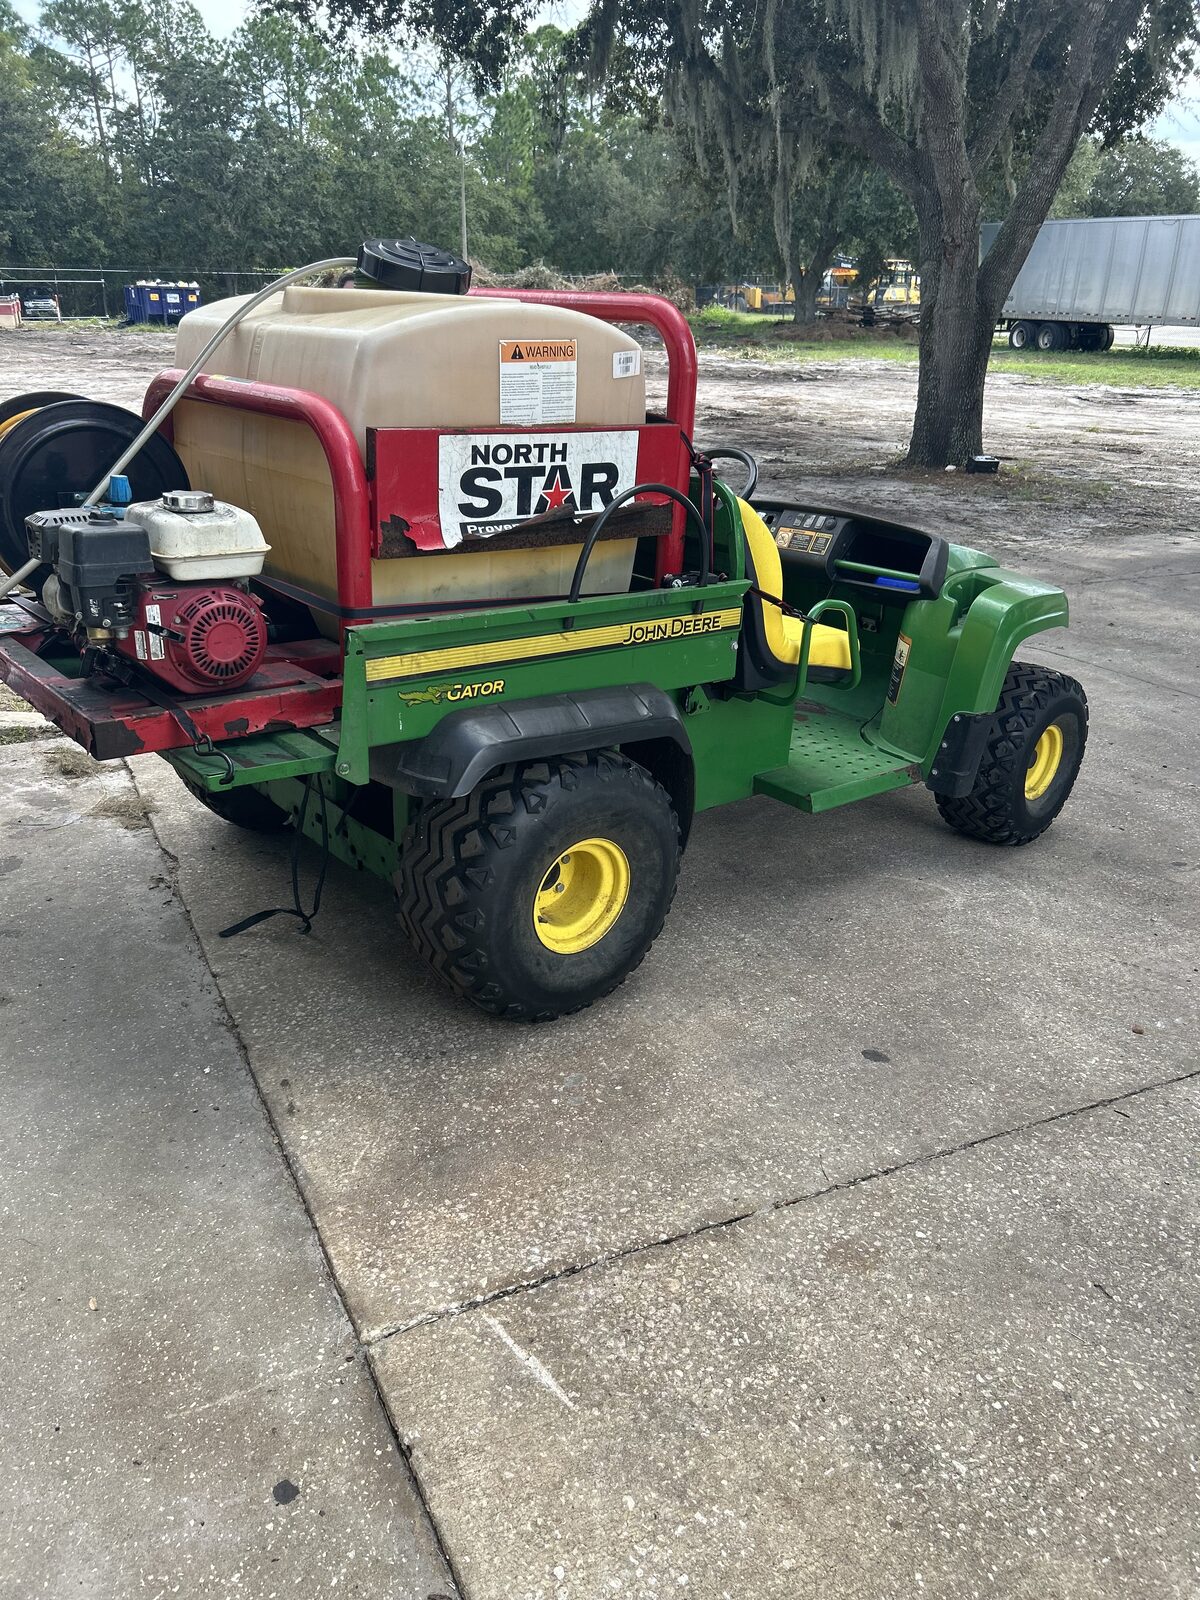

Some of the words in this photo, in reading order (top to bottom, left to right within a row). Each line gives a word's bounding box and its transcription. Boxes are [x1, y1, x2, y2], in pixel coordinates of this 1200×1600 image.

[525, 346, 574, 358] WARNING
[471, 443, 568, 465] NORTH
[457, 462, 620, 519] STAR
[623, 624, 668, 644] JOHN
[671, 616, 722, 636] DEERE
[447, 680, 505, 701] GATOR
